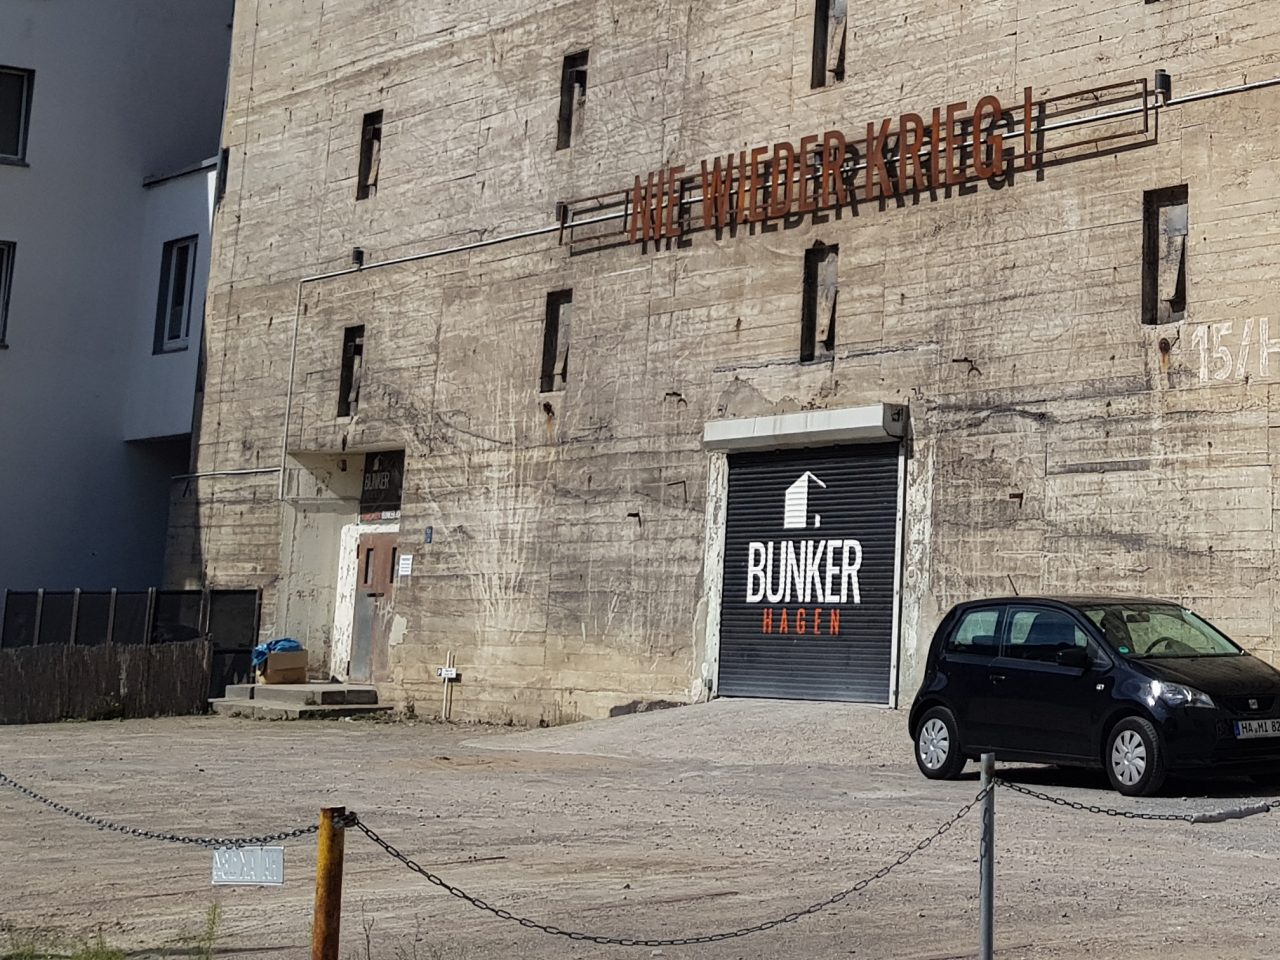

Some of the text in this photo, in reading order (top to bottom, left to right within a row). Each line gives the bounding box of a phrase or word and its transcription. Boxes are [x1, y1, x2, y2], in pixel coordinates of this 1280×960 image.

[628, 164, 686, 243] NIE
[701, 129, 847, 230] WIEDER
[745, 538, 863, 605] BUNKER
[762, 607, 841, 636] HAGEN
[1241, 721, 1254, 735] HA
